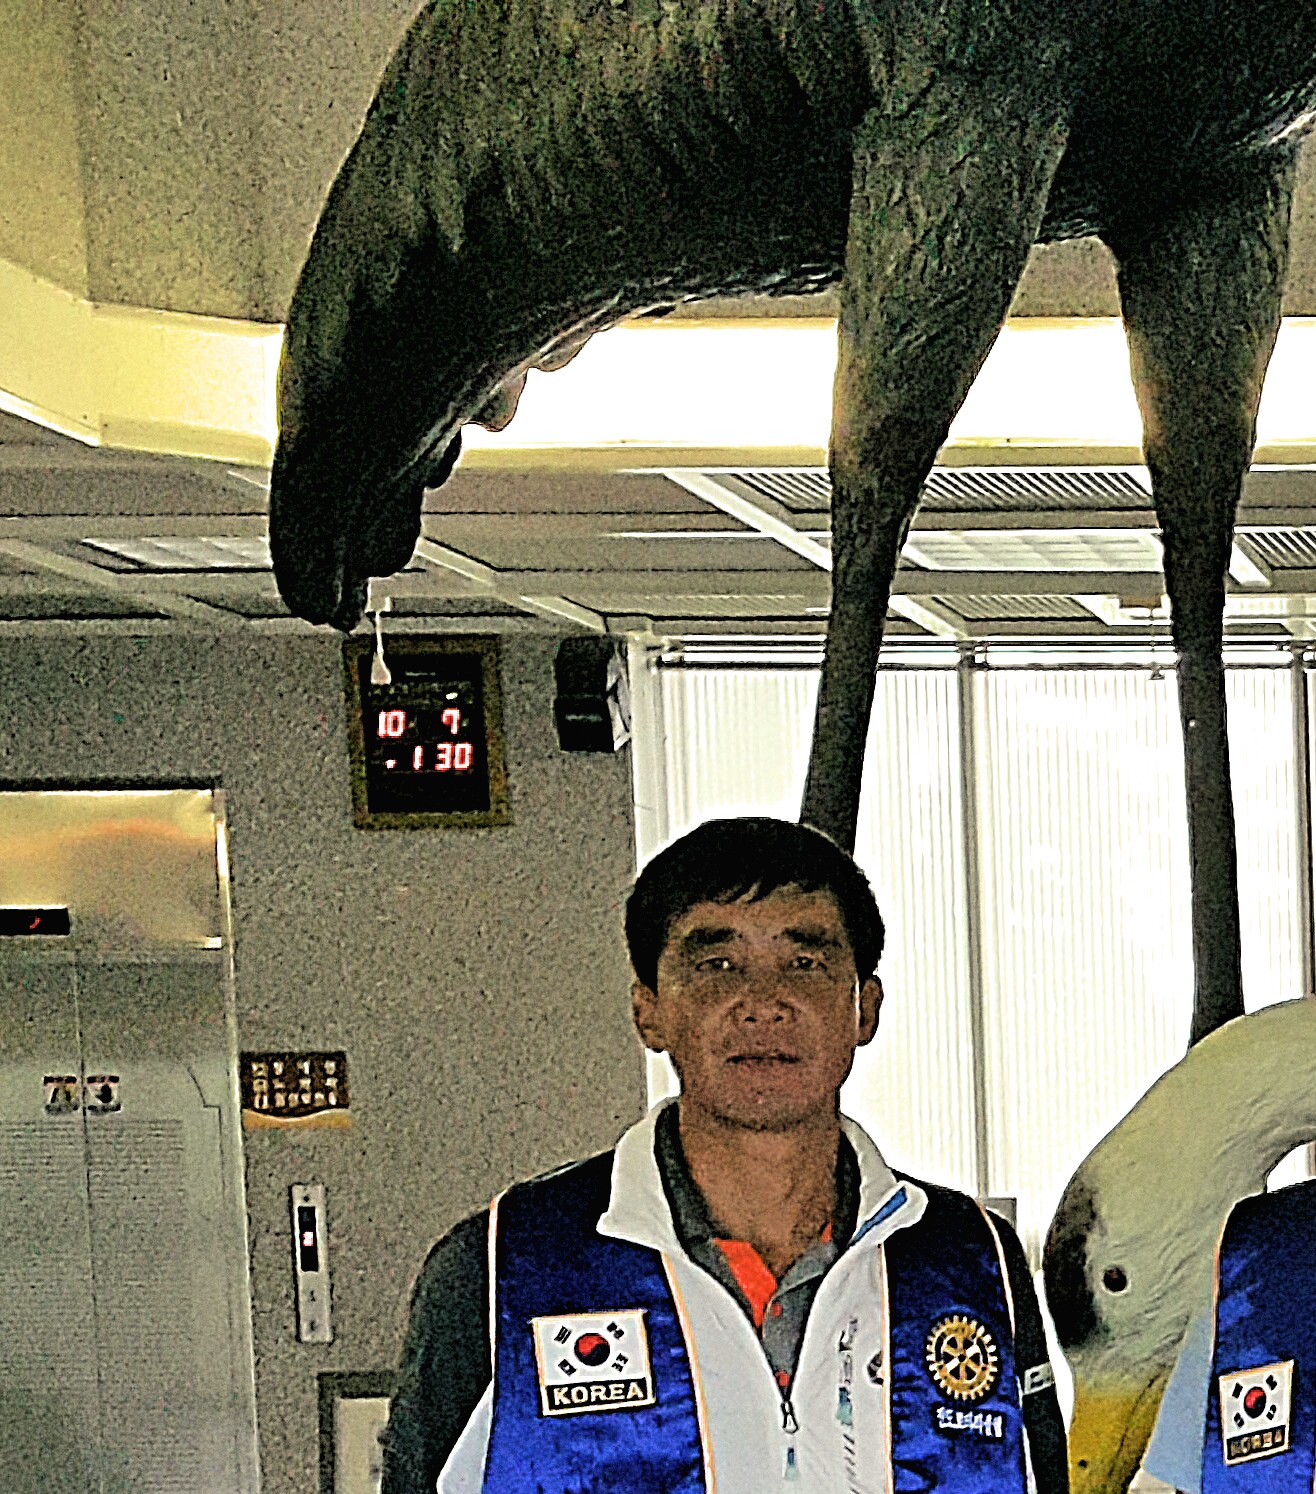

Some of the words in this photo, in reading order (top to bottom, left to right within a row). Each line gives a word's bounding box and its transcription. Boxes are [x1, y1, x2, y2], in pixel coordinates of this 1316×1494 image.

[376, 709, 407, 739] 10
[440, 706, 463, 735] 7
[553, 1381, 645, 1406] KOREA
